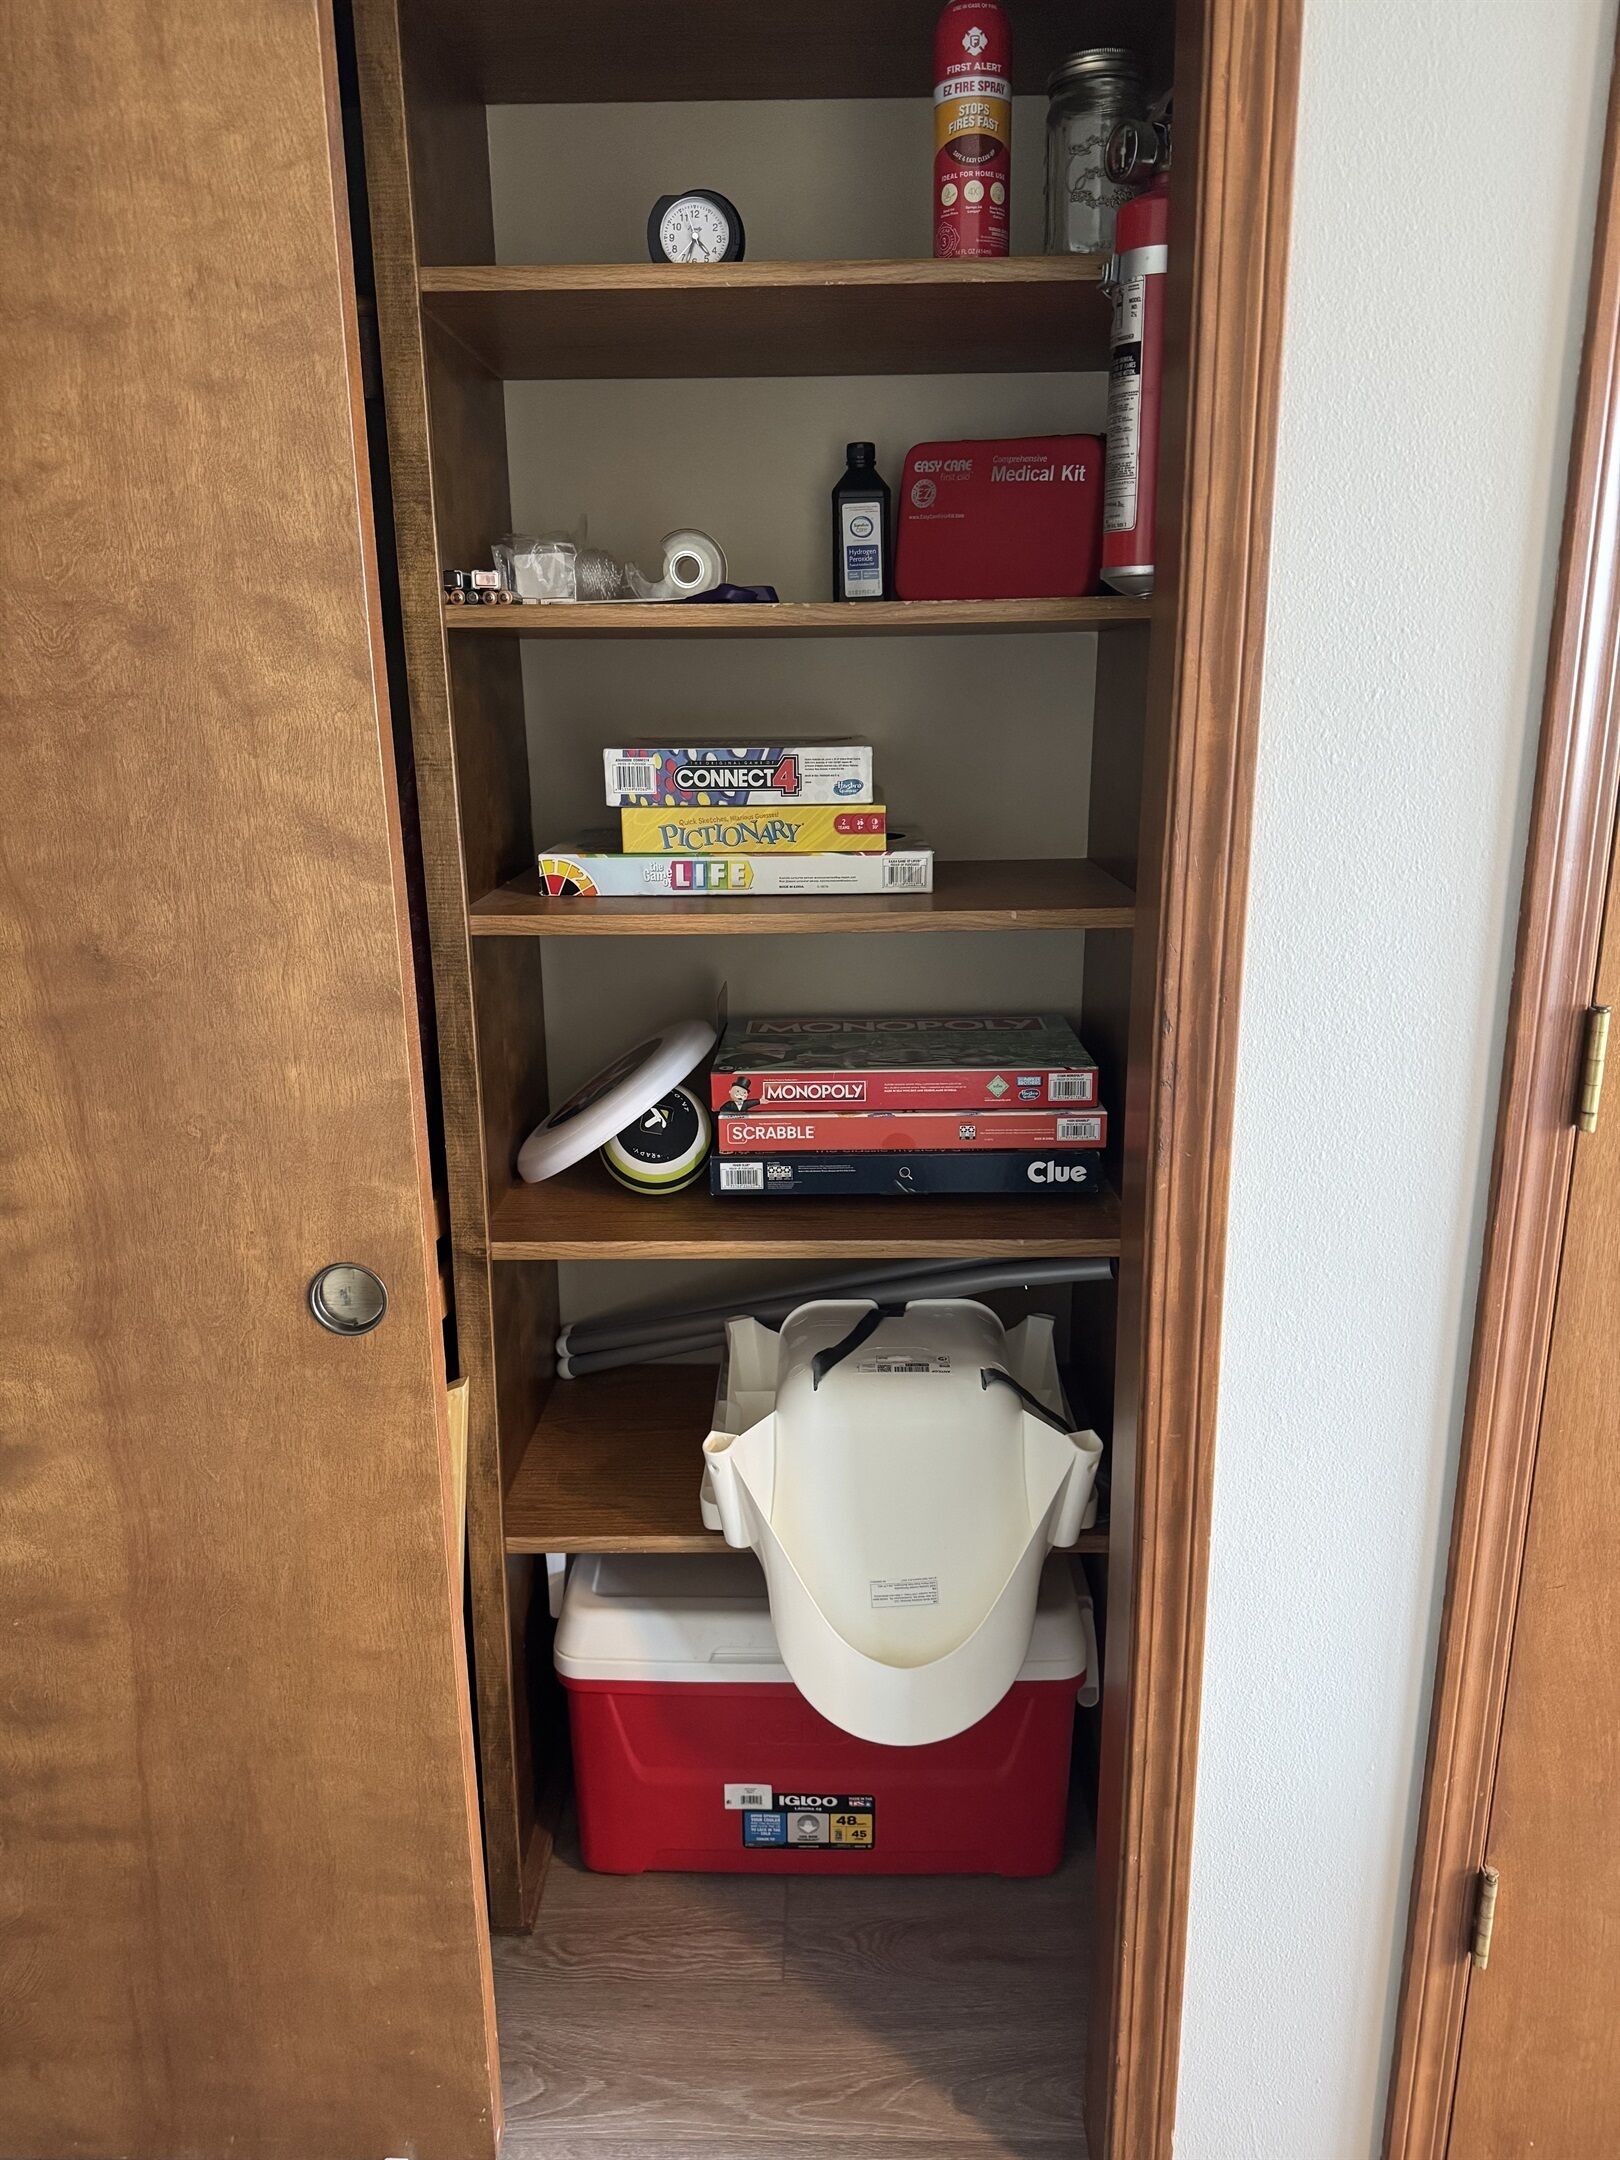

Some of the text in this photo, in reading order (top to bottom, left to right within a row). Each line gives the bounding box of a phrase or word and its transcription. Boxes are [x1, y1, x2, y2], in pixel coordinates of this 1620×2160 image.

[947, 62, 1002, 75] FIRST ALERT
[943, 80, 1006, 97] EZ FIRE SPRAY
[959, 103, 990, 117] STOPS
[948, 115, 999, 135] FIRES FAST
[942, 172, 958, 182] IDEAL
[960, 170, 973, 178] FOR
[975, 170, 994, 178] HOME
[680, 213, 689, 221] 11
[690, 209, 700, 219] 12
[704, 214, 709, 222] 1
[672, 223, 682, 231] 10
[712, 223, 719, 232] 2
[669, 233, 675, 242] 9
[716, 235, 722, 243] 3
[672, 245, 678, 253] 8
[711, 246, 717, 254] 4
[992, 455, 1048, 464] Comprehensive
[914, 460, 973, 472] EASY CARE
[991, 464, 1086, 482] Medical Kit
[916, 488, 931, 500] EZ
[848, 548, 877, 558] Hydrogen
[848, 555, 873, 563] Peroxide
[676, 769, 775, 787] CONNECT
[772, 758, 798, 793] 4
[837, 781, 862, 790] Hasbro
[678, 819, 696, 827] Quick
[730, 814, 754, 822] Hilarious
[755, 811, 780, 819] Guesses!
[657, 820, 801, 850] PICTIONARY
[650, 862, 664, 872] the
[644, 866, 672, 883] Game
[675, 862, 747, 888] LIFE
[758, 1017, 1034, 1034] MONOPOLY
[767, 1084, 863, 1099] MONOPOLY
[732, 1126, 815, 1139] SCRABBLE
[1027, 1160, 1088, 1184] Clue
[779, 1795, 838, 1807] IGLOO
[836, 1816, 857, 1826] 48
[852, 1830, 867, 1838] 45
